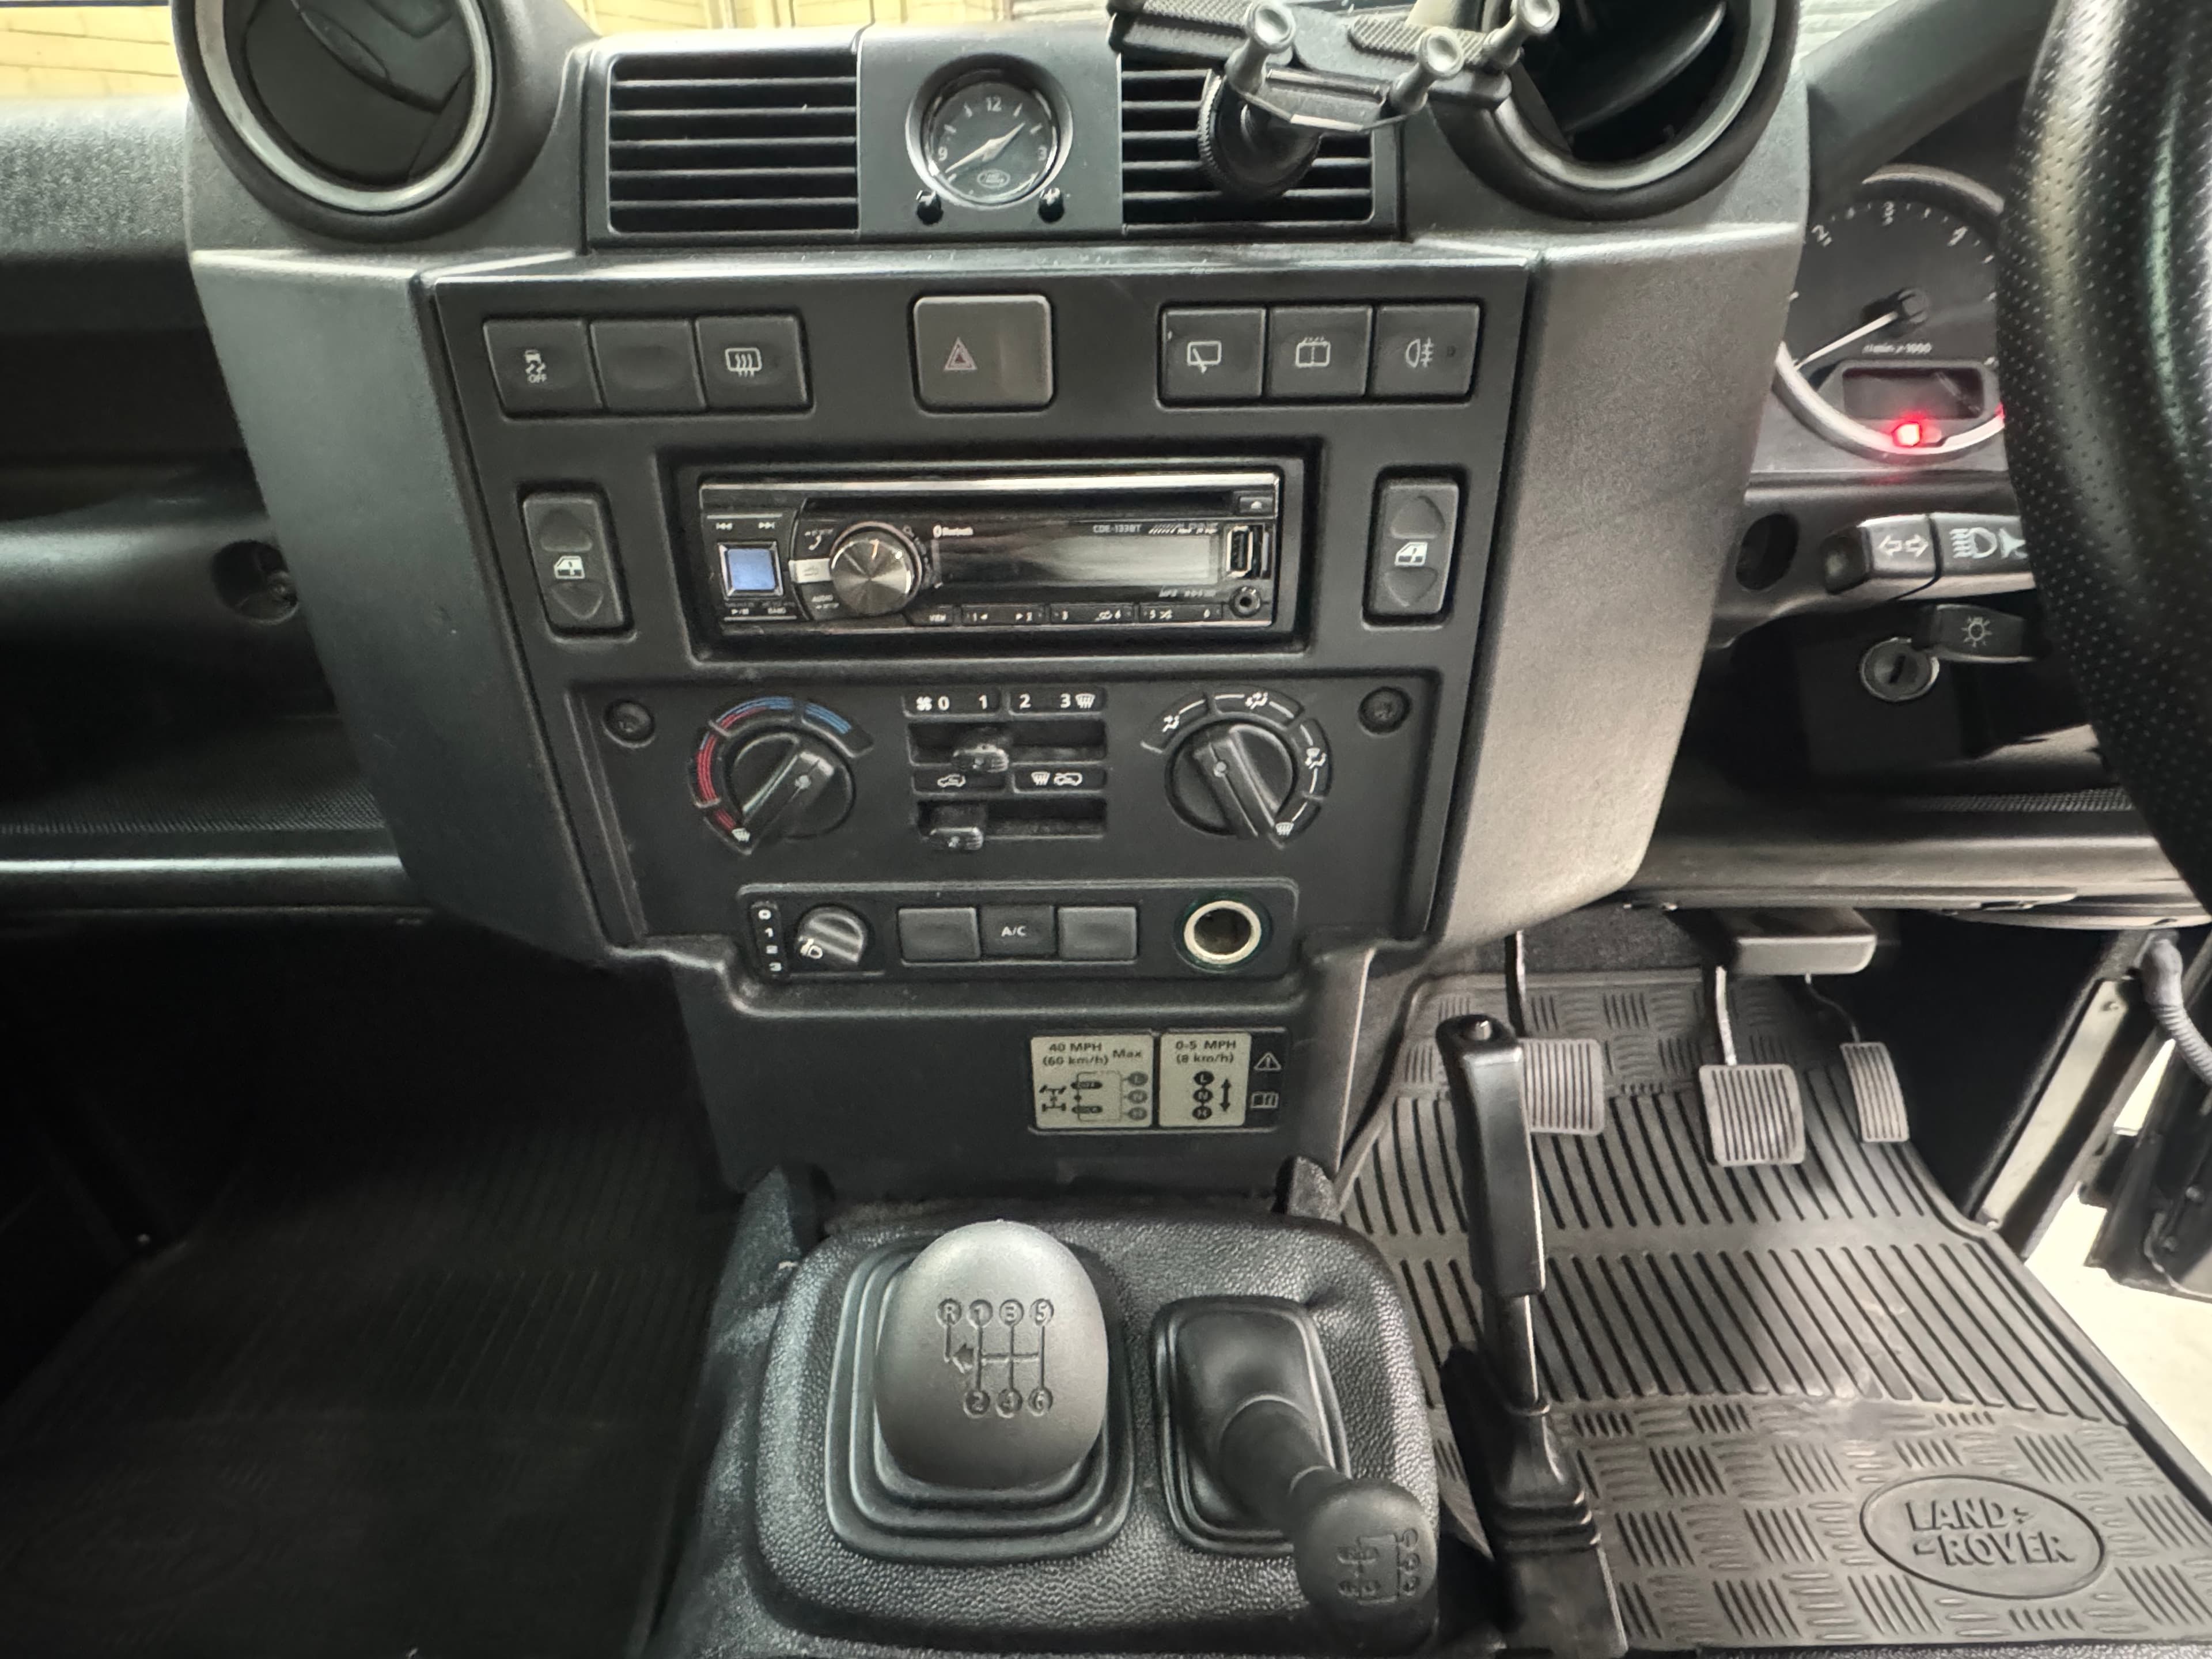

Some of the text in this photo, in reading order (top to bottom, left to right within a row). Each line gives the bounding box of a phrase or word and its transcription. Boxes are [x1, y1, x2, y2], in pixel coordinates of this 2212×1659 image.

[987, 97, 1002, 112] 12
[938, 146, 948, 161] 9
[1037, 146, 1047, 161] 3
[938, 694, 1071, 711] 0 1 2 3
[758, 910, 772, 921] 0
[764, 927, 774, 938] 1
[1001, 926, 1027, 937] A/C
[769, 962, 782, 972] 3
[1050, 1042, 1103, 1052] 40 MPH
[1176, 1040, 1237, 1050] 0-5 MPH
[1113, 1047, 1142, 1058] Max
[1194, 1050, 1234, 1063] km/h)
[1069, 1054, 1109, 1066] km/h)
[1200, 1074, 1207, 1083] L
[1906, 1498, 2007, 1531] LAND
[1937, 1530, 2077, 1566] ROVER
